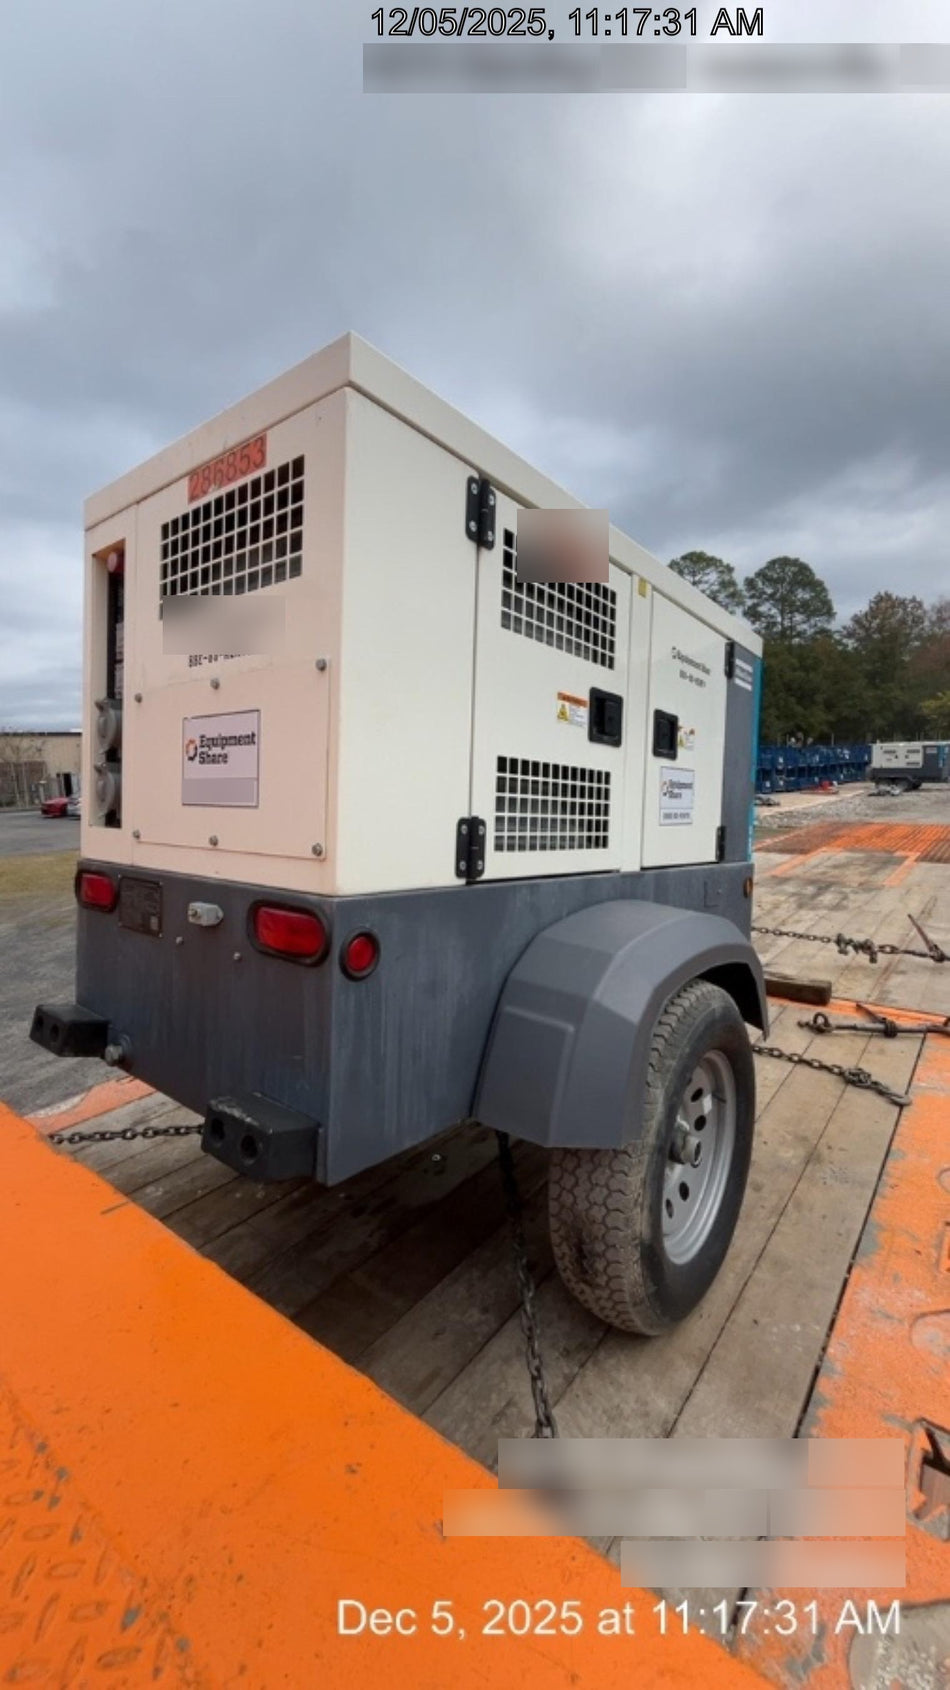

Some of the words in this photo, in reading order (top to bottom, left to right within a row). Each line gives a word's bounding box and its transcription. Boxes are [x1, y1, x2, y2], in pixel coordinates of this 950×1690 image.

[189, 437, 265, 502] 286853
[199, 731, 257, 751] Equipment
[198, 751, 229, 765] Share
